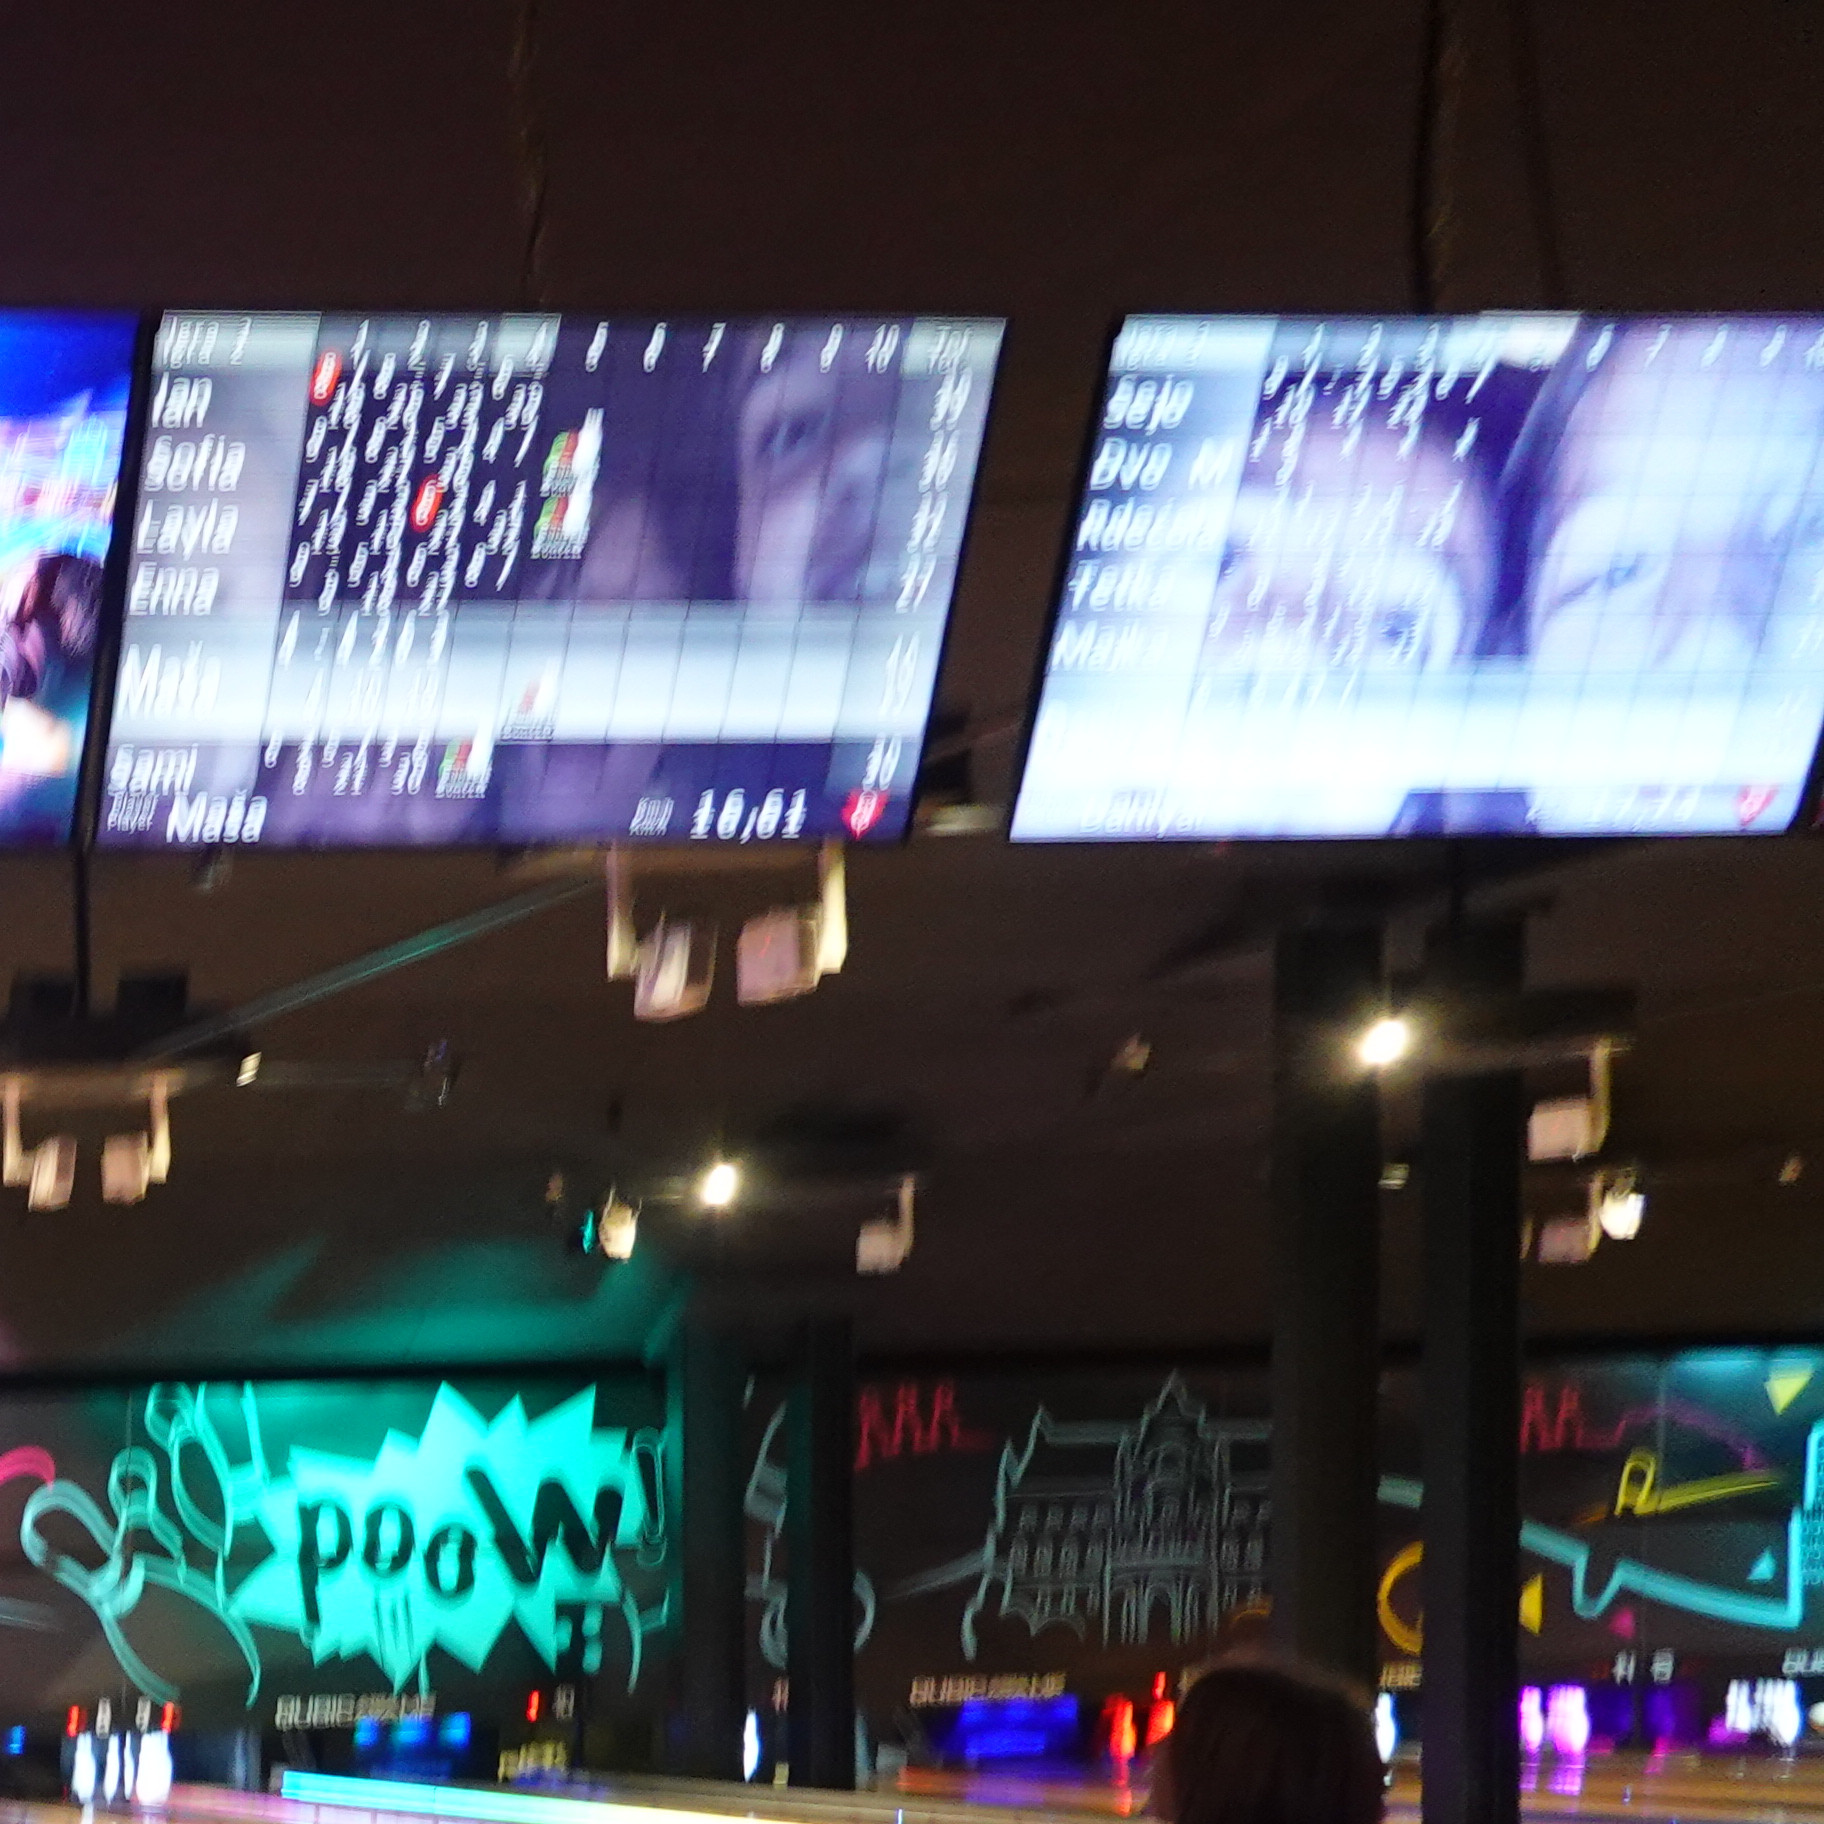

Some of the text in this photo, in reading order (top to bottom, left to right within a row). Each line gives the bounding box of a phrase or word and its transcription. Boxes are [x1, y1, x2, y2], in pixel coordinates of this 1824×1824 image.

[144, 433, 246, 492] Sofia
[137, 497, 239, 562] Layla
[129, 561, 220, 616] Enna
[166, 789, 267, 843] Maša
[690, 788, 807, 844] 16,61
